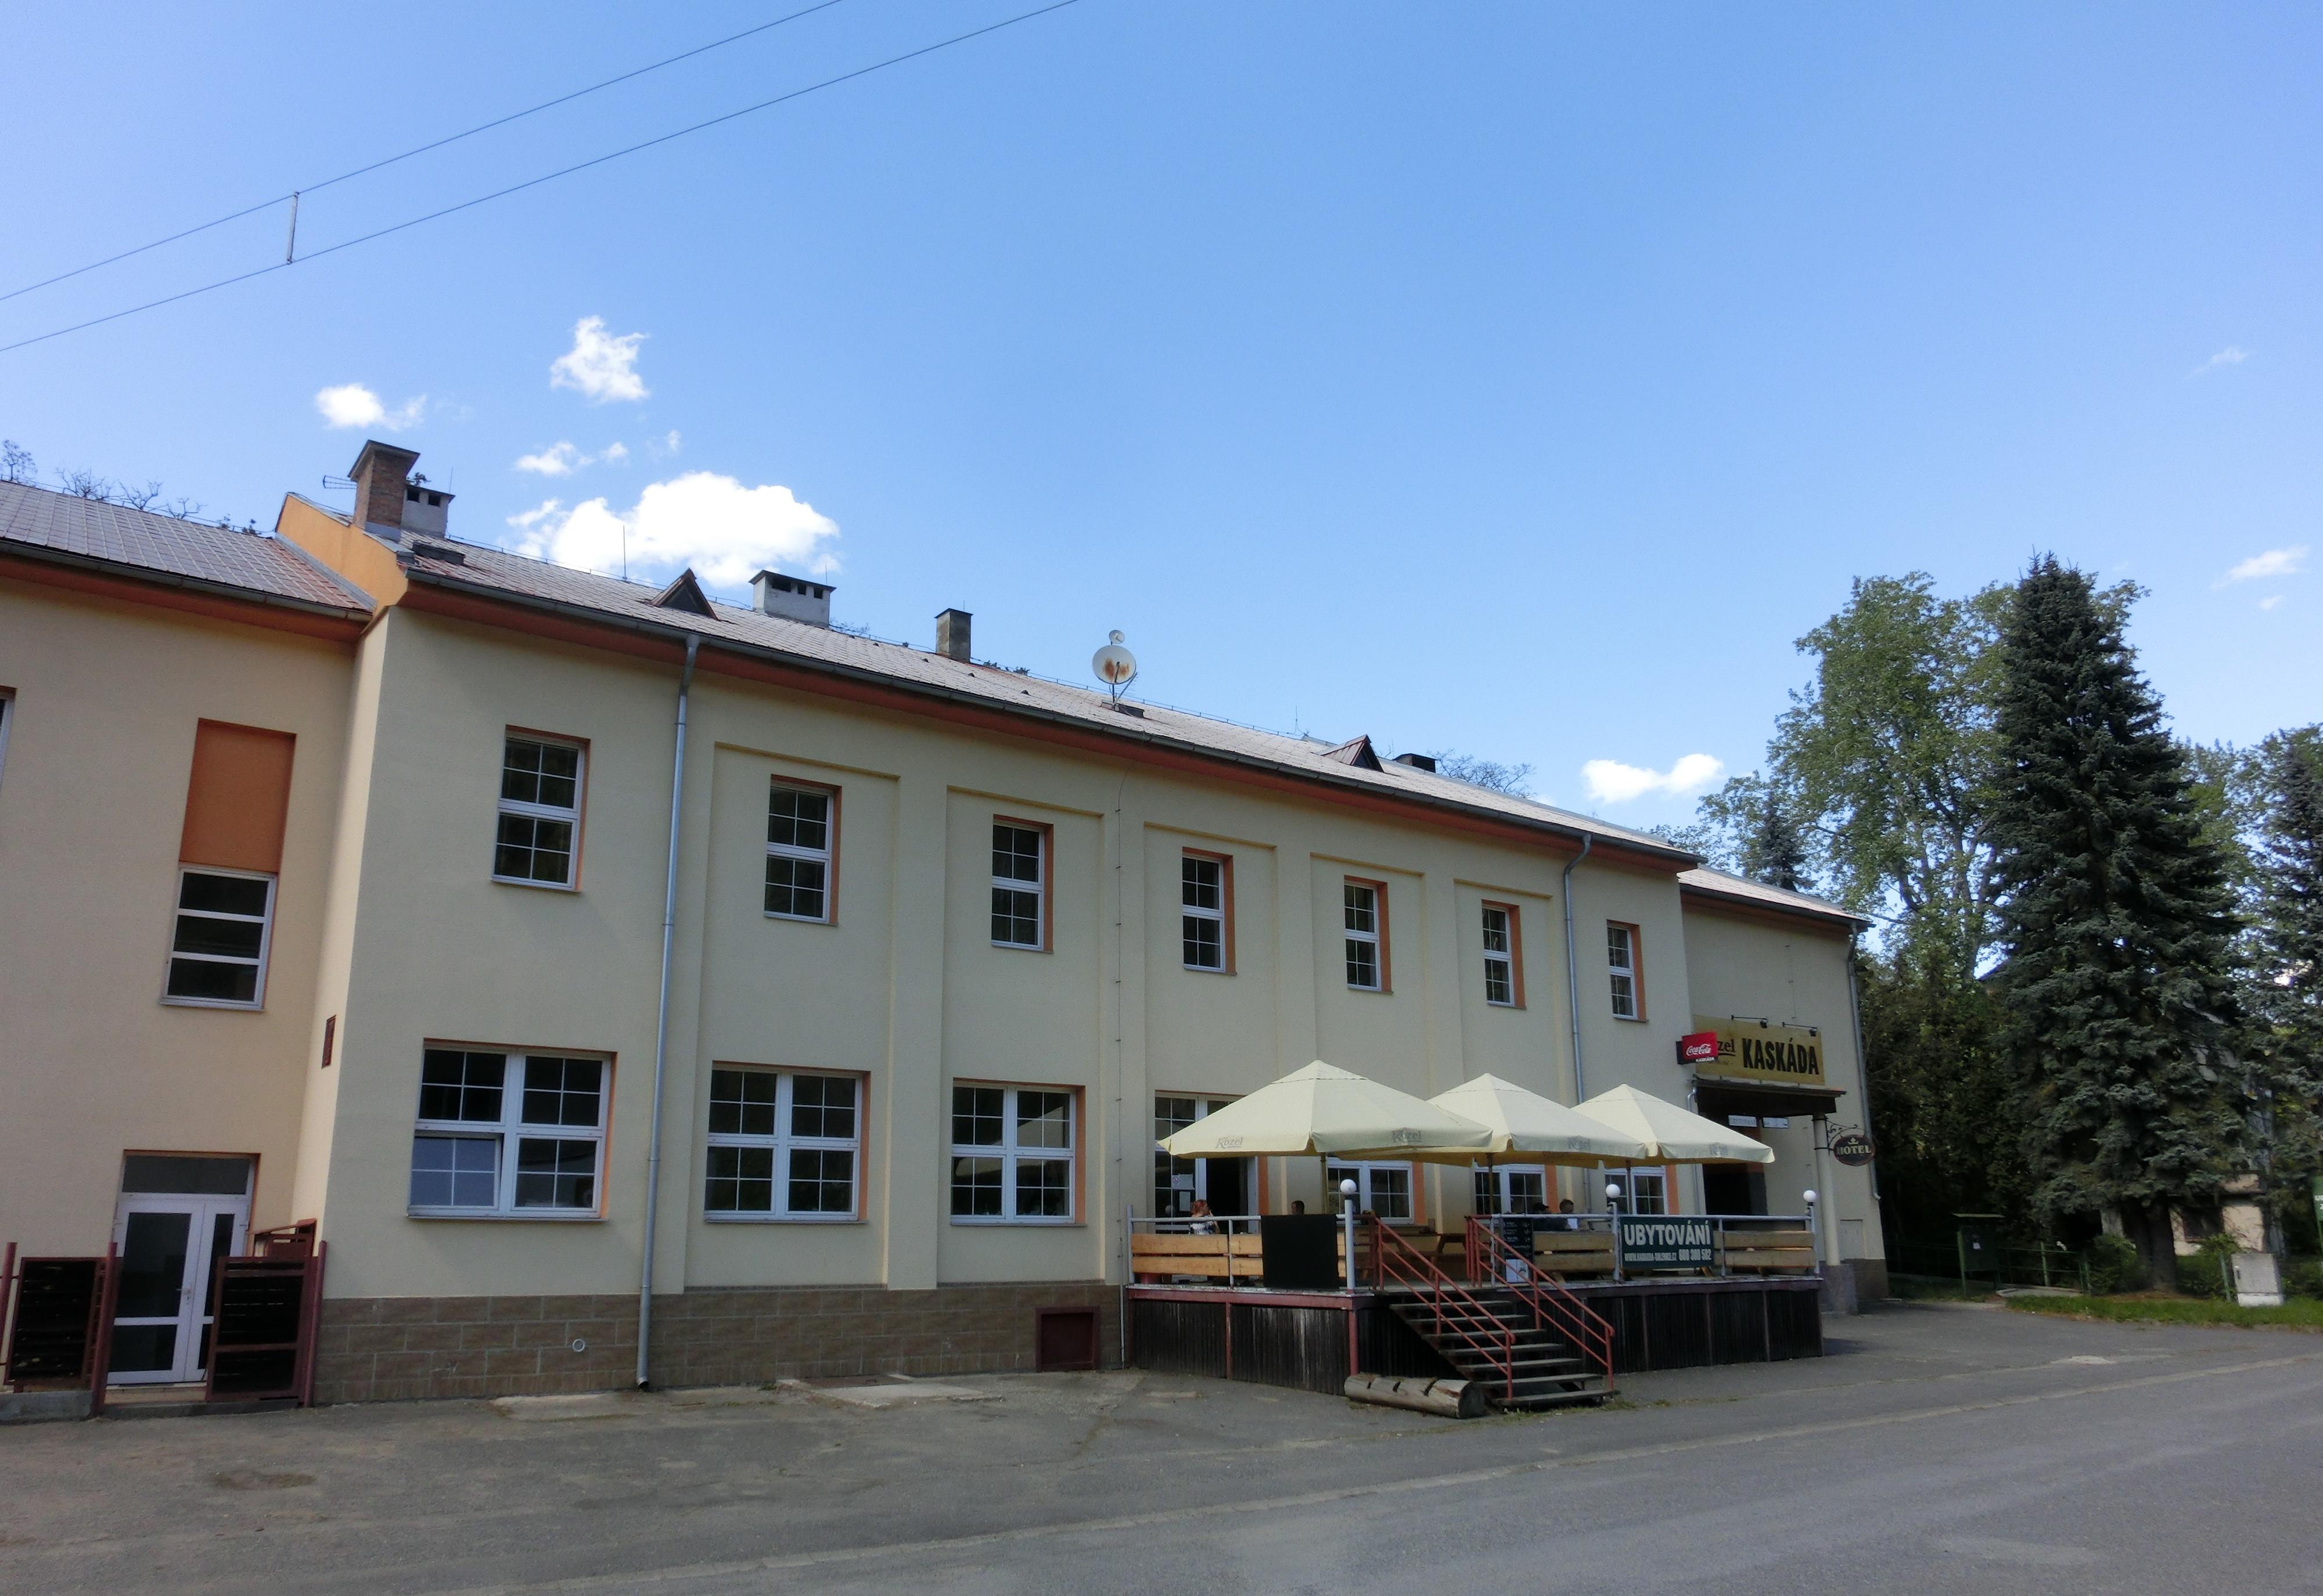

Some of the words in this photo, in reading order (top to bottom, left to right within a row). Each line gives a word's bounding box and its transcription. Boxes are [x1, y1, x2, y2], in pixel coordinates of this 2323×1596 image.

[1742, 1037, 1819, 1074] KASKÁDA
[1214, 1137, 1243, 1149] Kozel
[1836, 1145, 1871, 1155] HOTEL
[1624, 1220, 1711, 1246] UBYTOVÁNÍ
